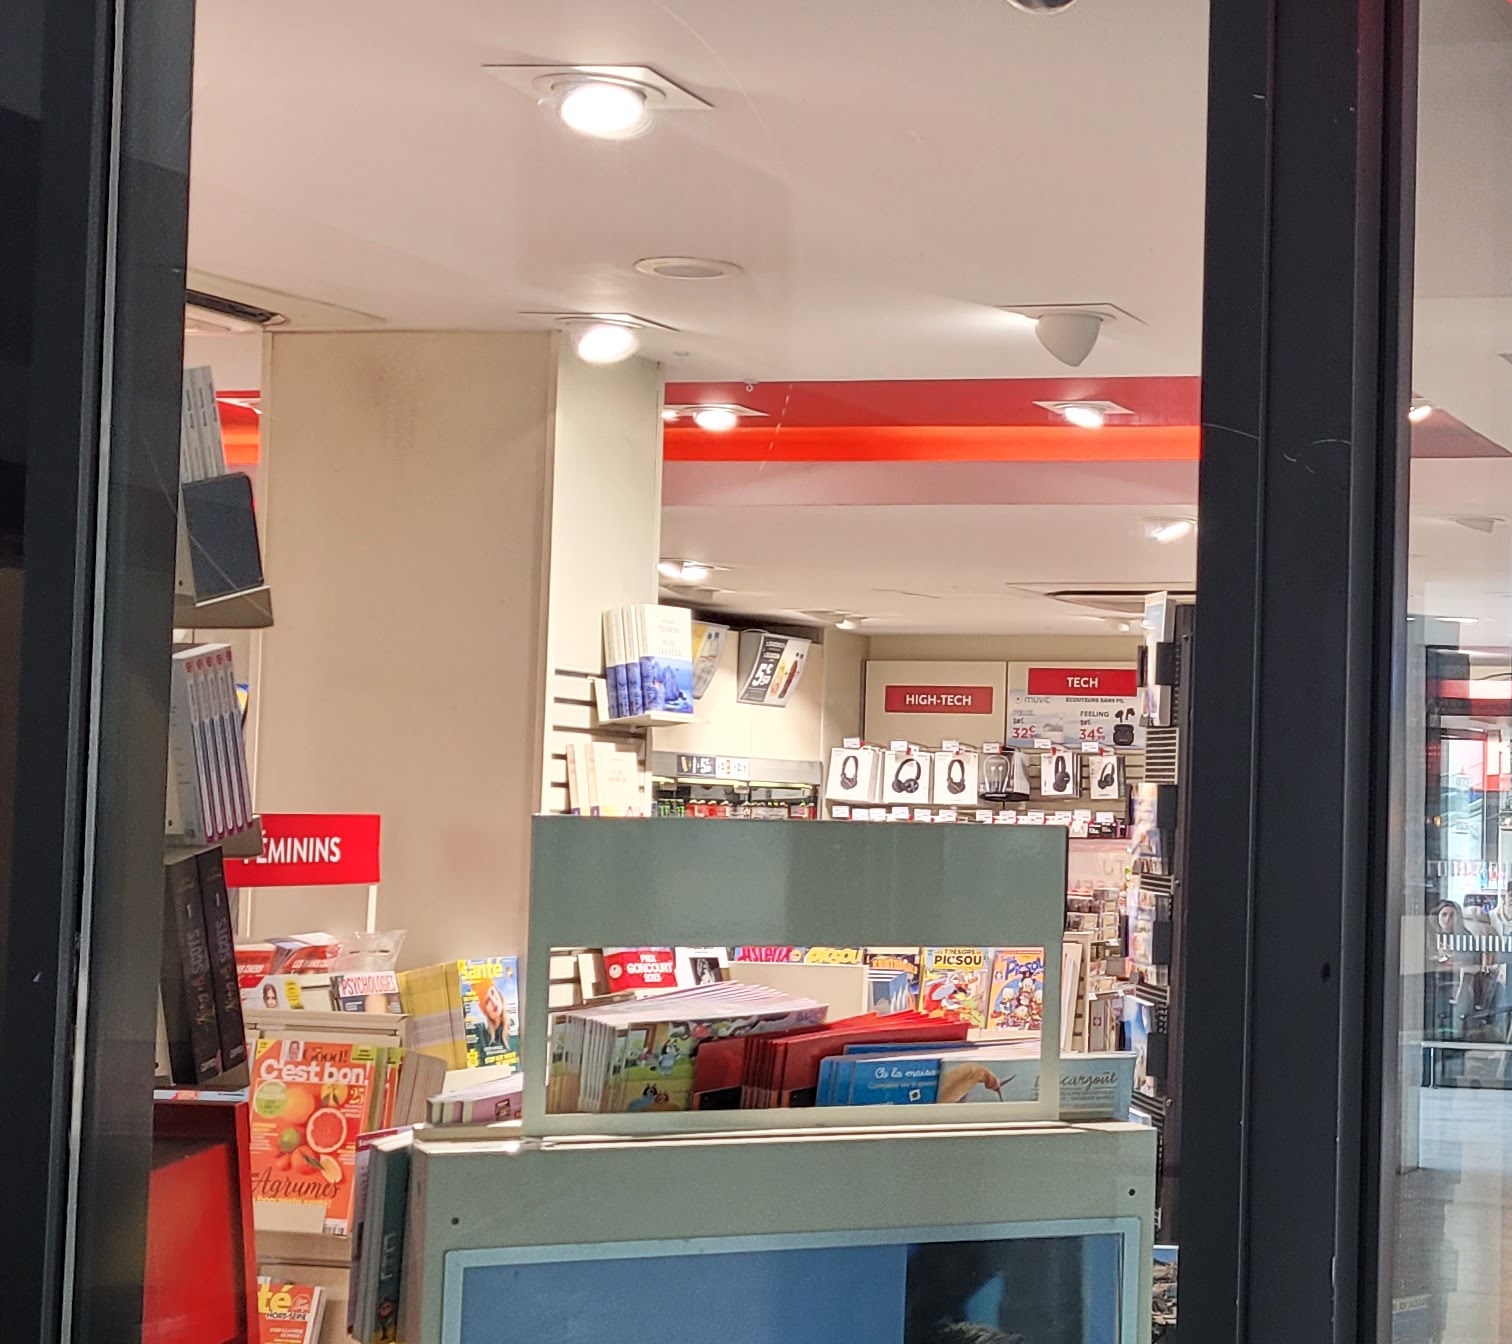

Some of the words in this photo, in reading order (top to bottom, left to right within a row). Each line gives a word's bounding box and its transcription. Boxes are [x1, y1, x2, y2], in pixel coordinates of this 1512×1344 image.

[1066, 676, 1099, 688] TECH
[905, 694, 972, 706] HIGH-TECH
[1080, 710, 1109, 718] FEELING
[243, 830, 342, 865] ÉMININS
[933, 955, 981, 966] PICSOU
[626, 962, 673, 974] GONCOURT
[260, 1058, 321, 1084] C'est
[322, 1060, 371, 1087] bon!
[251, 1166, 341, 1199] Agrumes
